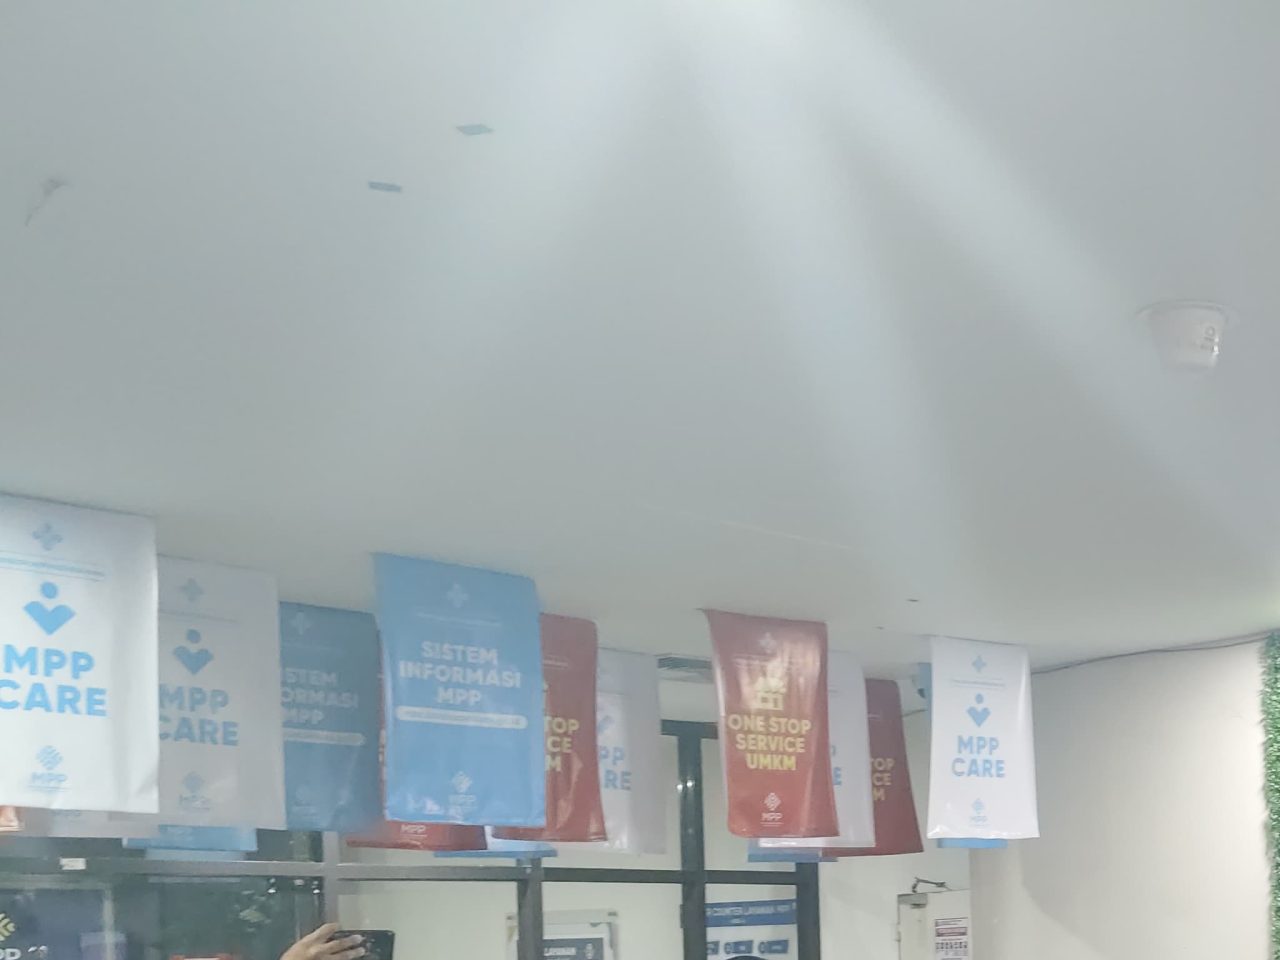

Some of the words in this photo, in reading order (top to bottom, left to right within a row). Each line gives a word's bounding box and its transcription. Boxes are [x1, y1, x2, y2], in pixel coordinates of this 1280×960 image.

[3, 643, 95, 680] MPP
[420, 641, 499, 666] SISTEM
[284, 666, 339, 686] STEM
[398, 661, 522, 689] INFORMASI
[0, 678, 108, 717] CARE
[159, 683, 229, 714] MPP
[281, 687, 360, 709] ORMASI
[436, 686, 482, 706] MPP
[544, 715, 580, 736] TOP
[728, 714, 766, 733] ONE
[768, 716, 812, 735] STOP
[735, 733, 806, 754] SERVICE
[957, 735, 1000, 757] MPP
[599, 745, 624, 767] PP
[746, 753, 797, 772] UMKM
[950, 757, 1006, 779] CARE
[604, 769, 632, 791] RE
